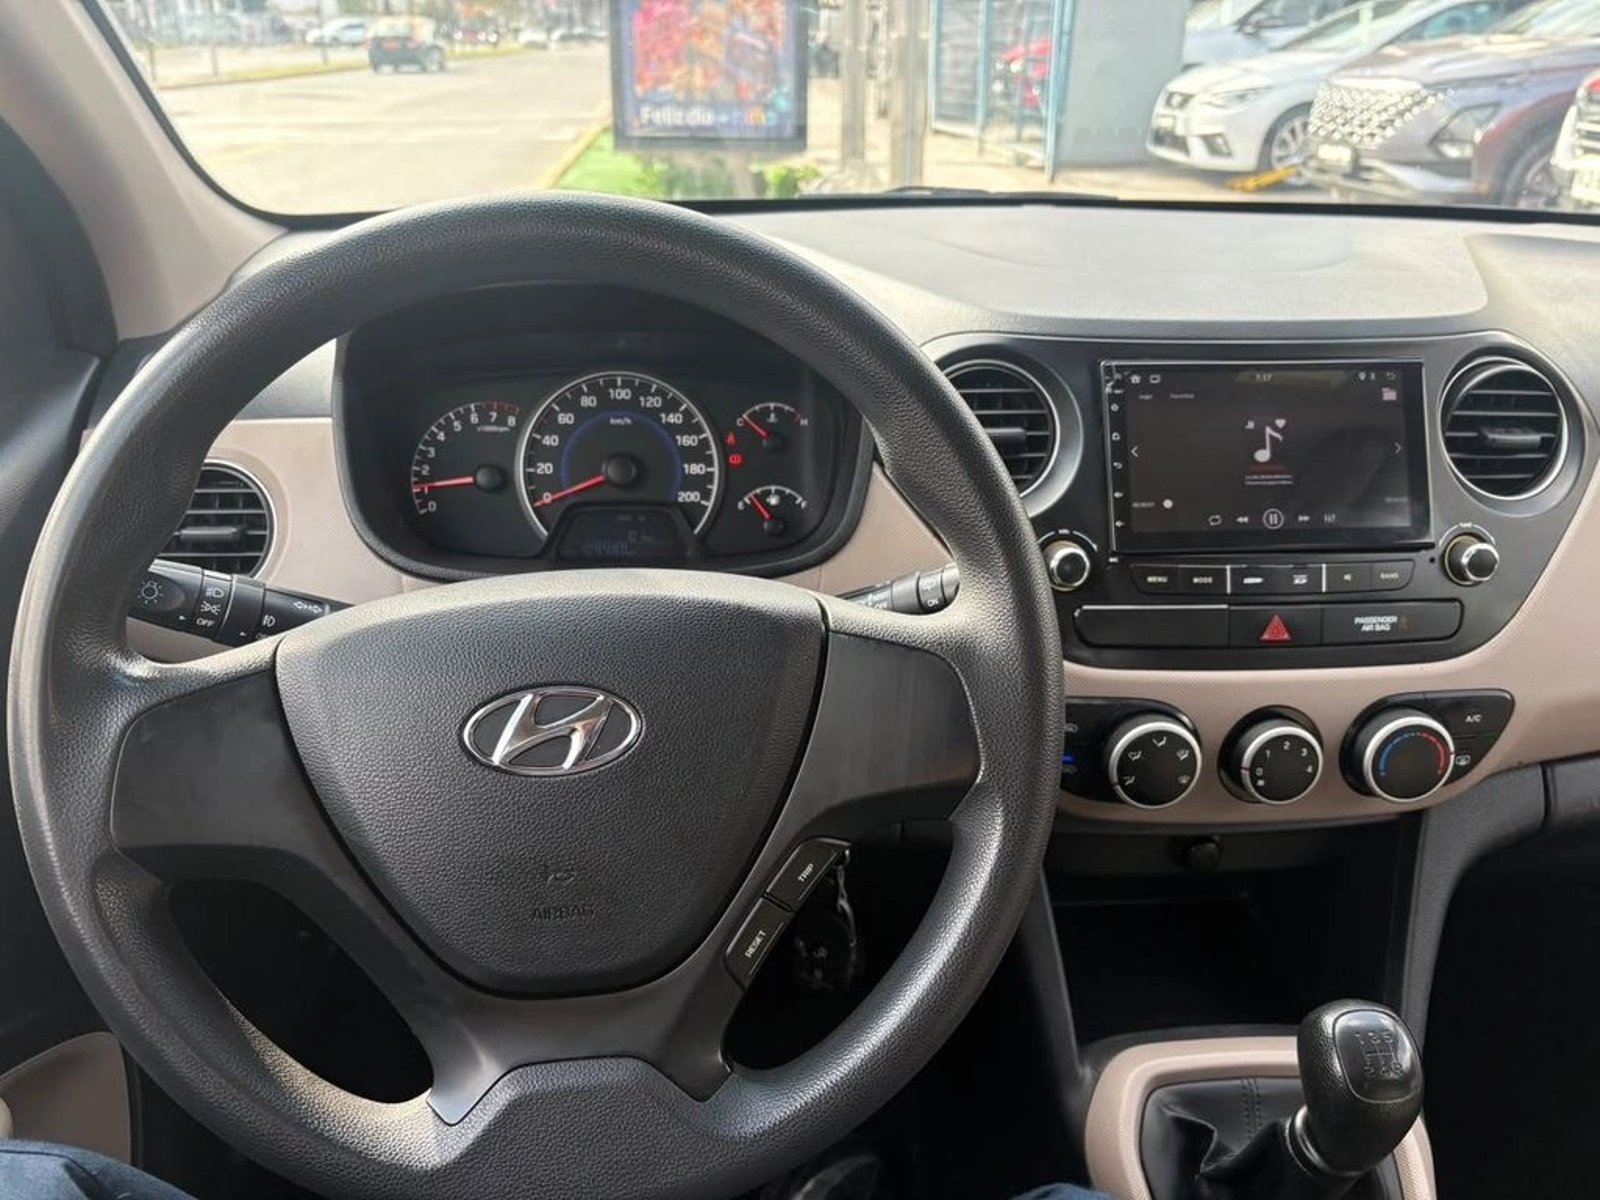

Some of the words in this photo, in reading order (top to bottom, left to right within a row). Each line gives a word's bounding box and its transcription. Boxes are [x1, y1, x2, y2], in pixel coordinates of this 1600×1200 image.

[608, 388, 632, 400] 100
[580, 396, 597, 407] 80
[640, 396, 662, 408] 120
[470, 412, 479, 424] 6
[489, 411, 498, 423] 7
[507, 415, 517, 427] 8
[558, 413, 574, 425] 60
[660, 412, 683, 424] 140
[453, 420, 462, 432] 5
[436, 431, 445, 442] 4
[542, 434, 559, 446] 40
[675, 435, 698, 446] 160
[426, 447, 436, 458] 3
[421, 464, 430, 476] 2
[536, 462, 553, 474] 20
[683, 463, 706, 475] 180
[542, 492, 551, 504] 0
[677, 491, 701, 503] 200
[428, 501, 437, 512] 0
[1146, 575, 1168, 583] MENU
[1192, 576, 1213, 584] MODE
[196, 618, 215, 627] OFF
[1354, 615, 1398, 625] PASSENGER
[1361, 624, 1374, 632] AIR
[1375, 623, 1391, 632] BAG
[1283, 740, 1290, 750] 2
[1301, 748, 1308, 757] 3
[1305, 765, 1313, 774] 4
[744, 930, 766, 958] RESET
